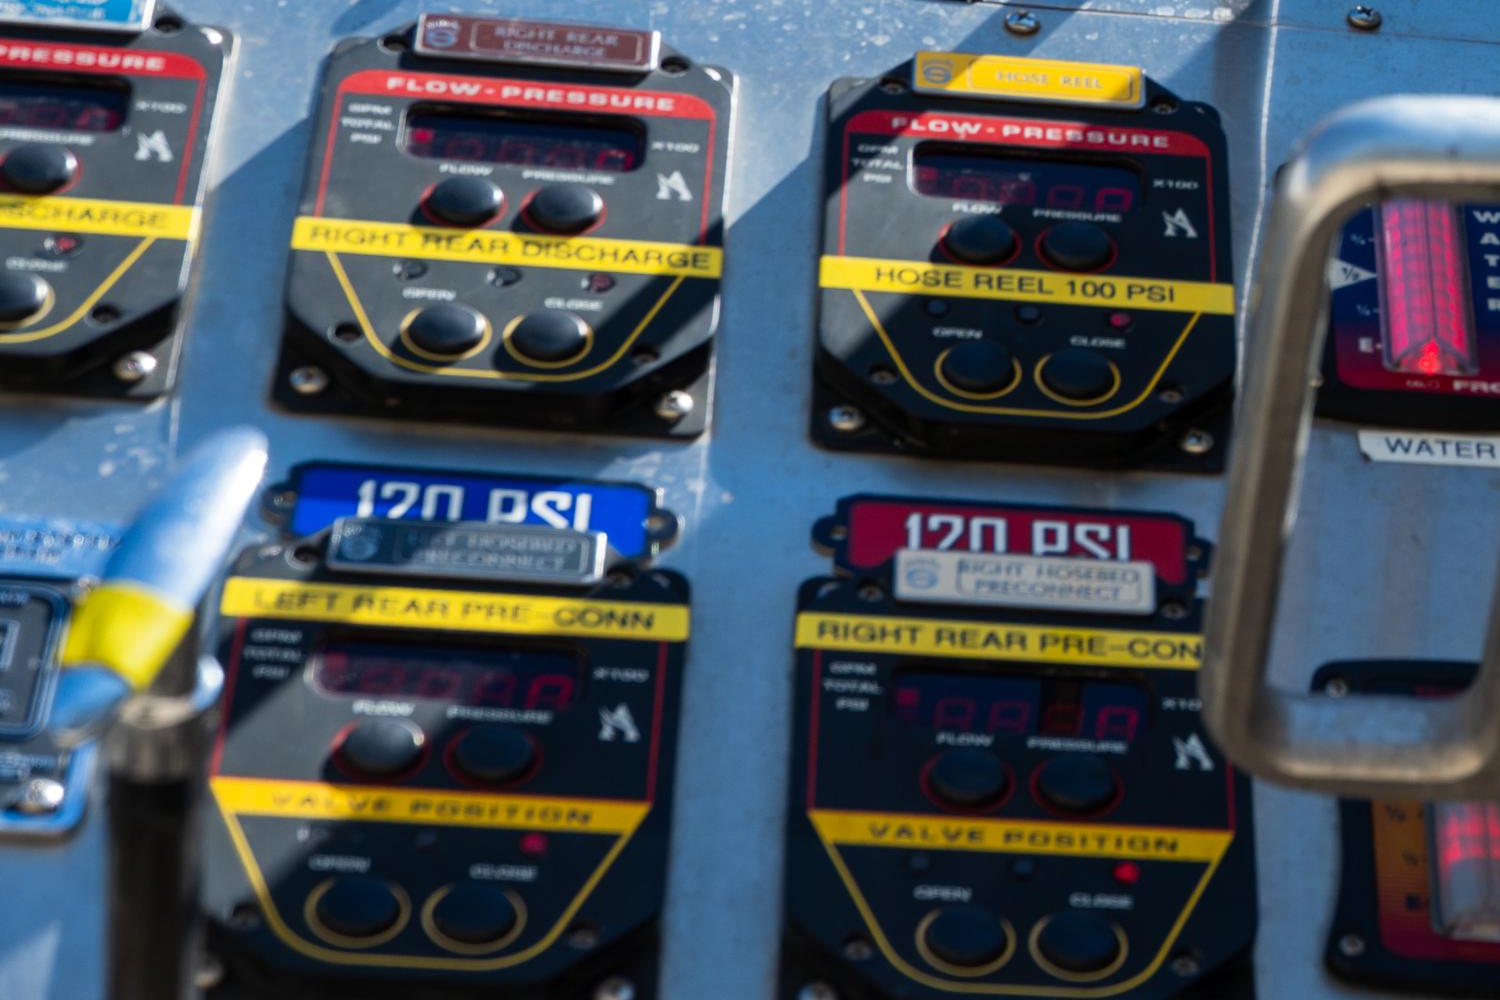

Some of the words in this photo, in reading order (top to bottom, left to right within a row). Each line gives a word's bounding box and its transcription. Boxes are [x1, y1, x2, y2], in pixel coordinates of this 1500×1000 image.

[996, 70, 1050, 87] HOSE
[1061, 74, 1105, 90] REEL
[857, 143, 899, 155] GPM
[439, 163, 495, 177] FLOW
[852, 158, 905, 171] TOTAL
[522, 169, 617, 185] PRESSURE
[863, 172, 894, 184] PSI
[1152, 178, 1199, 190] X100
[952, 202, 1004, 215] FLOW
[1033, 208, 1122, 223] PRESSURE
[309, 225, 407, 248] RIGHT
[422, 233, 510, 256] REAR
[520, 241, 711, 270] DISCHARGE
[875, 267, 963, 290] HOSE
[974, 273, 1054, 296] REEL
[1066, 279, 1116, 300] 100
[1126, 283, 1175, 303] PSI
[933, 326, 983, 340] OPEN
[1070, 335, 1125, 349] CLOSE
[1358, 337, 1373, 352] E
[1384, 437, 1496, 459] WATER
[356, 480, 465, 521] 120
[486, 488, 592, 532] PSI
[905, 513, 1007, 553] 120
[1032, 520, 1130, 561] PSI
[958, 559, 1023, 575] RIGHT
[1036, 563, 1140, 583] HOSEBED
[254, 590, 337, 611] LEFT
[354, 595, 451, 619] REAR
[816, 620, 923, 645] RIGHT
[934, 627, 1028, 650] REAR
[1039, 632, 1201, 661] PRE-CON
[936, 731, 994, 747] FLOW
[1027, 736, 1129, 754] PRESSURE
[272, 790, 395, 814] VALVE
[410, 799, 593, 826] POSITION
[869, 823, 985, 844] VALVE
[1003, 830, 1179, 854] POSITION
